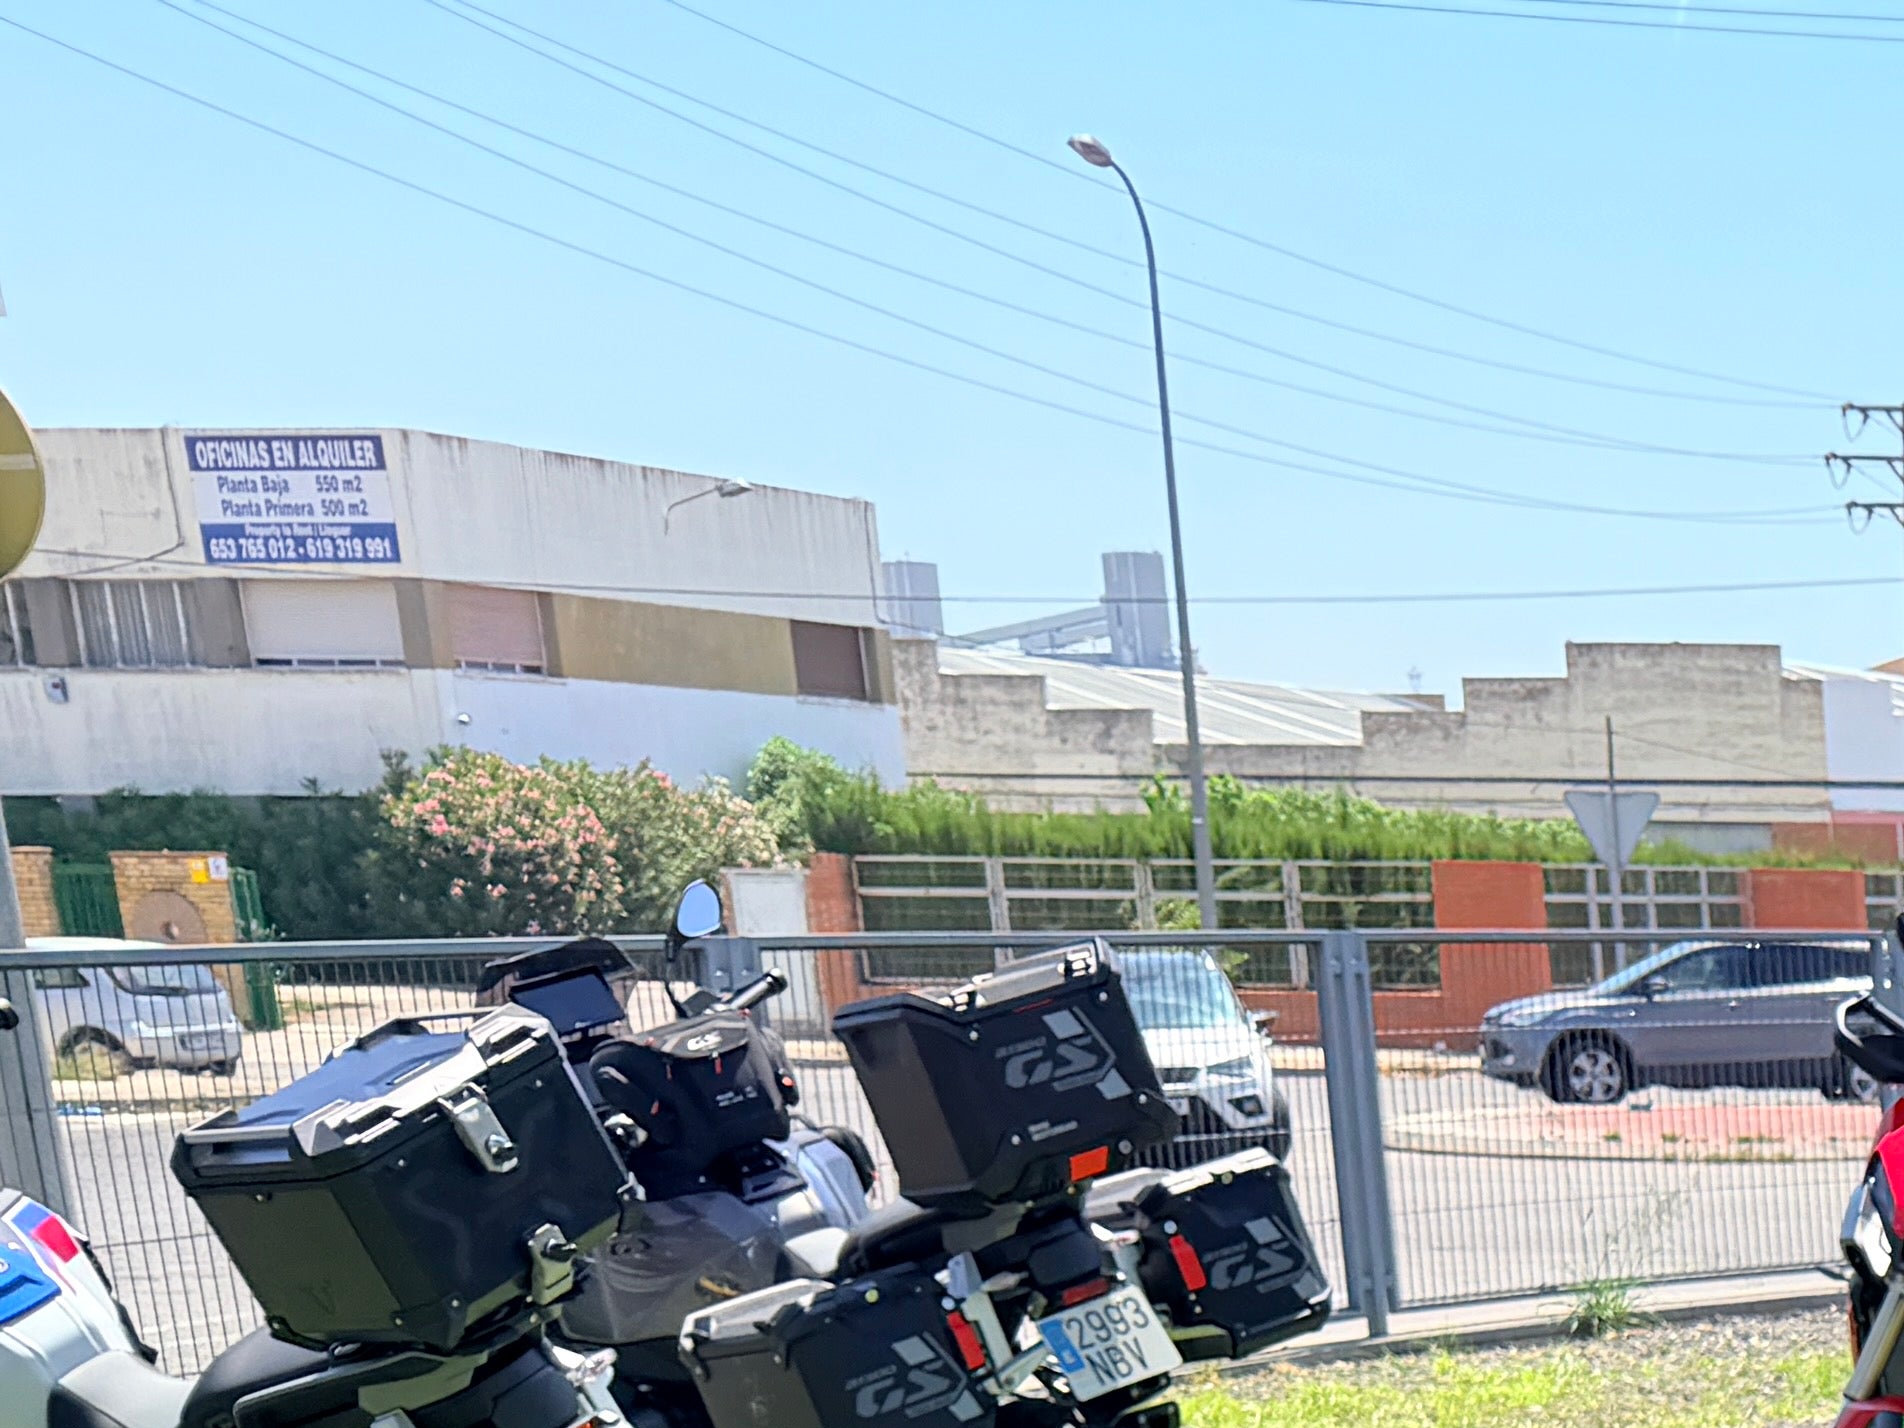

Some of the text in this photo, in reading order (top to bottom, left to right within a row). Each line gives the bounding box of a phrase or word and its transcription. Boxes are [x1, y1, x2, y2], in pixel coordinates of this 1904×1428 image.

[195, 439, 377, 468] OFICINAS EN ALQUILER
[217, 474, 363, 496] Planta Baja 550 m2
[221, 499, 369, 517] Planta Primera 500 m2
[210, 537, 393, 560] 653 765 012 619 319 991
[1065, 1297, 1149, 1350] 2993
[1085, 1337, 1148, 1386] NBV
